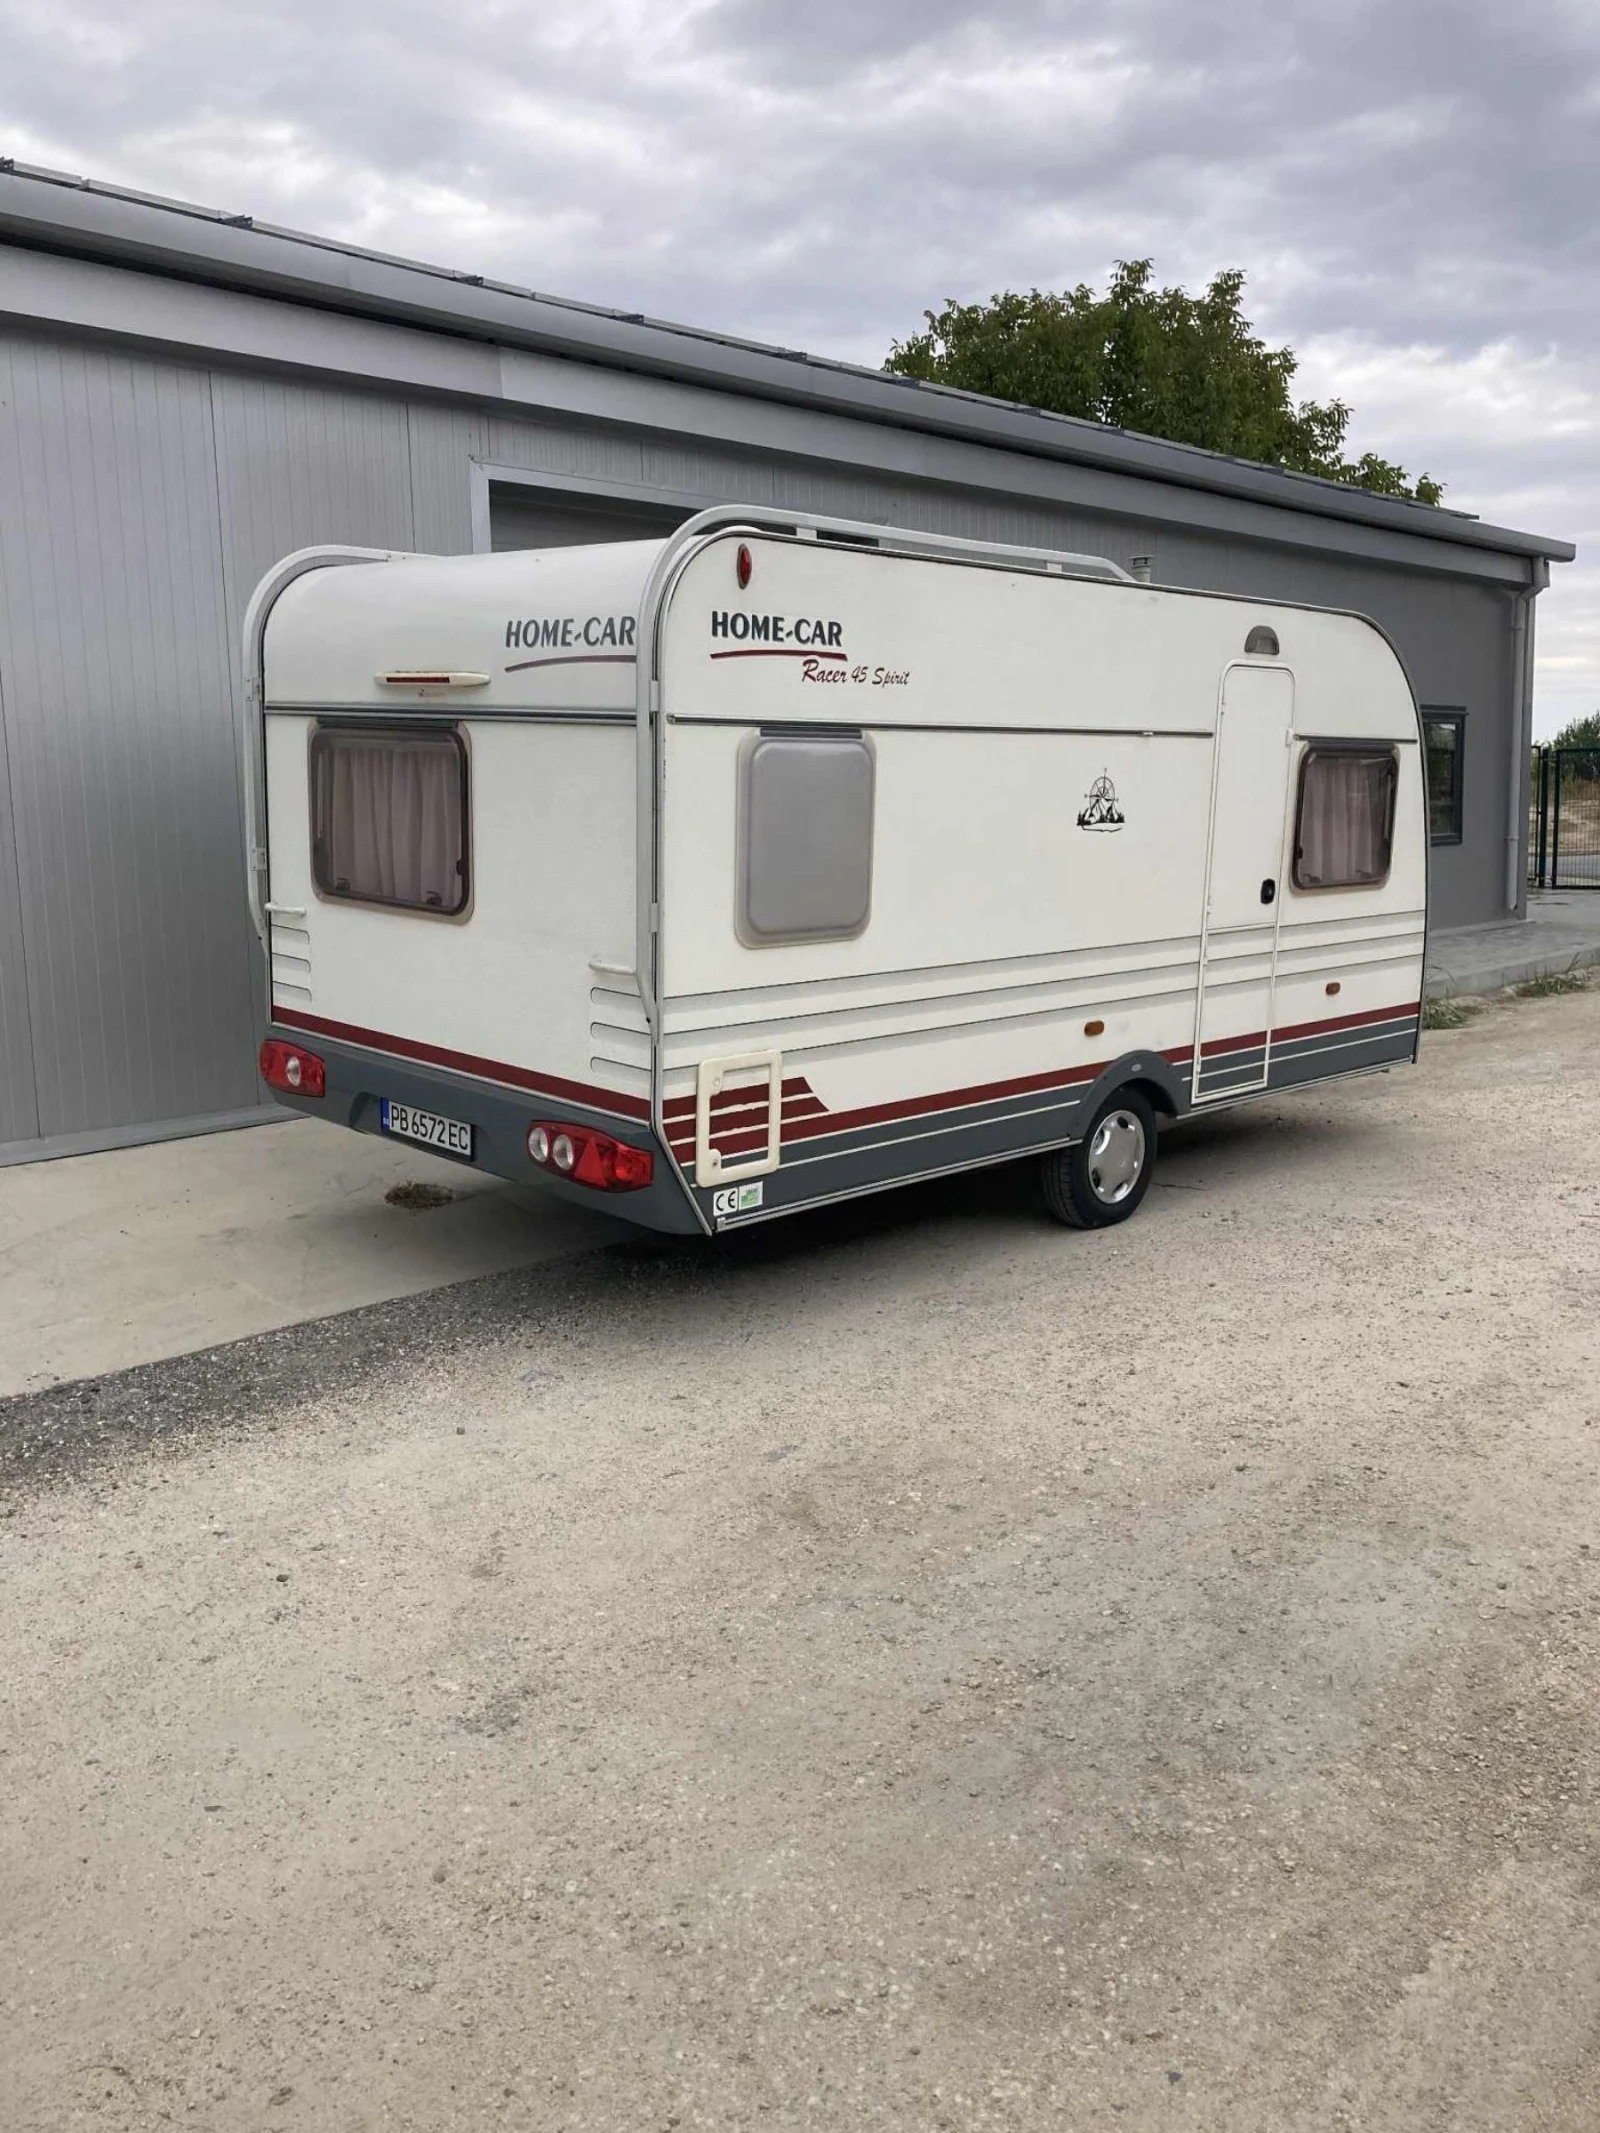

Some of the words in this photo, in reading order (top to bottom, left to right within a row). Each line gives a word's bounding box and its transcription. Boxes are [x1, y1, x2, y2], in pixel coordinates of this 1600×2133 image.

[505, 616, 636, 648] HOME-CAR
[711, 610, 842, 647] HOME-CAR
[801, 659, 847, 683] Racer
[851, 665, 869, 683] 45
[871, 667, 910, 688] Spirit
[716, 1190, 736, 1212] CE
